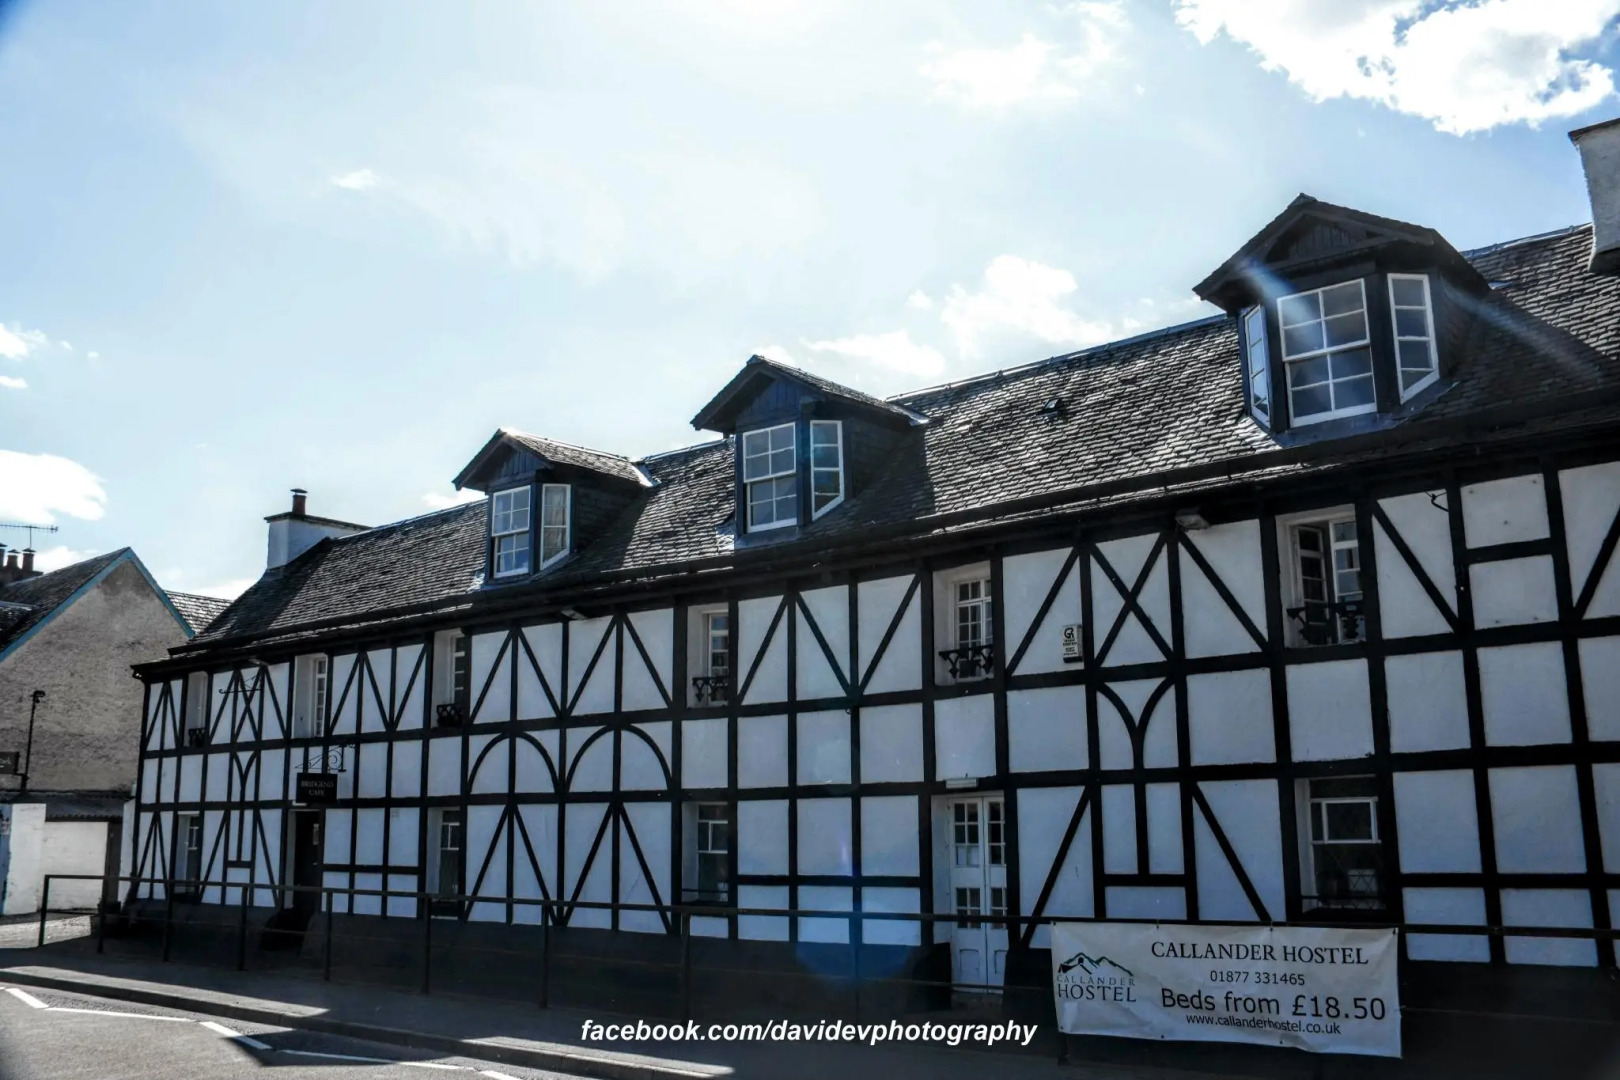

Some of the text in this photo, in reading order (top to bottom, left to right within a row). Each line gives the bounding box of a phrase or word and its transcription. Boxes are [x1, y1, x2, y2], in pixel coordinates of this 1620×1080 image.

[1151, 941, 1369, 965] CALLANDER HOSTEL
[1057, 974, 1136, 986] CALLANDER
[1210, 970, 1306, 986] 01877 331465
[1058, 983, 1137, 1002] HOSTEL
[1161, 988, 1386, 1020] Beds from £18.50
[1186, 1014, 1342, 1034] www.callanderhostel.co.uk
